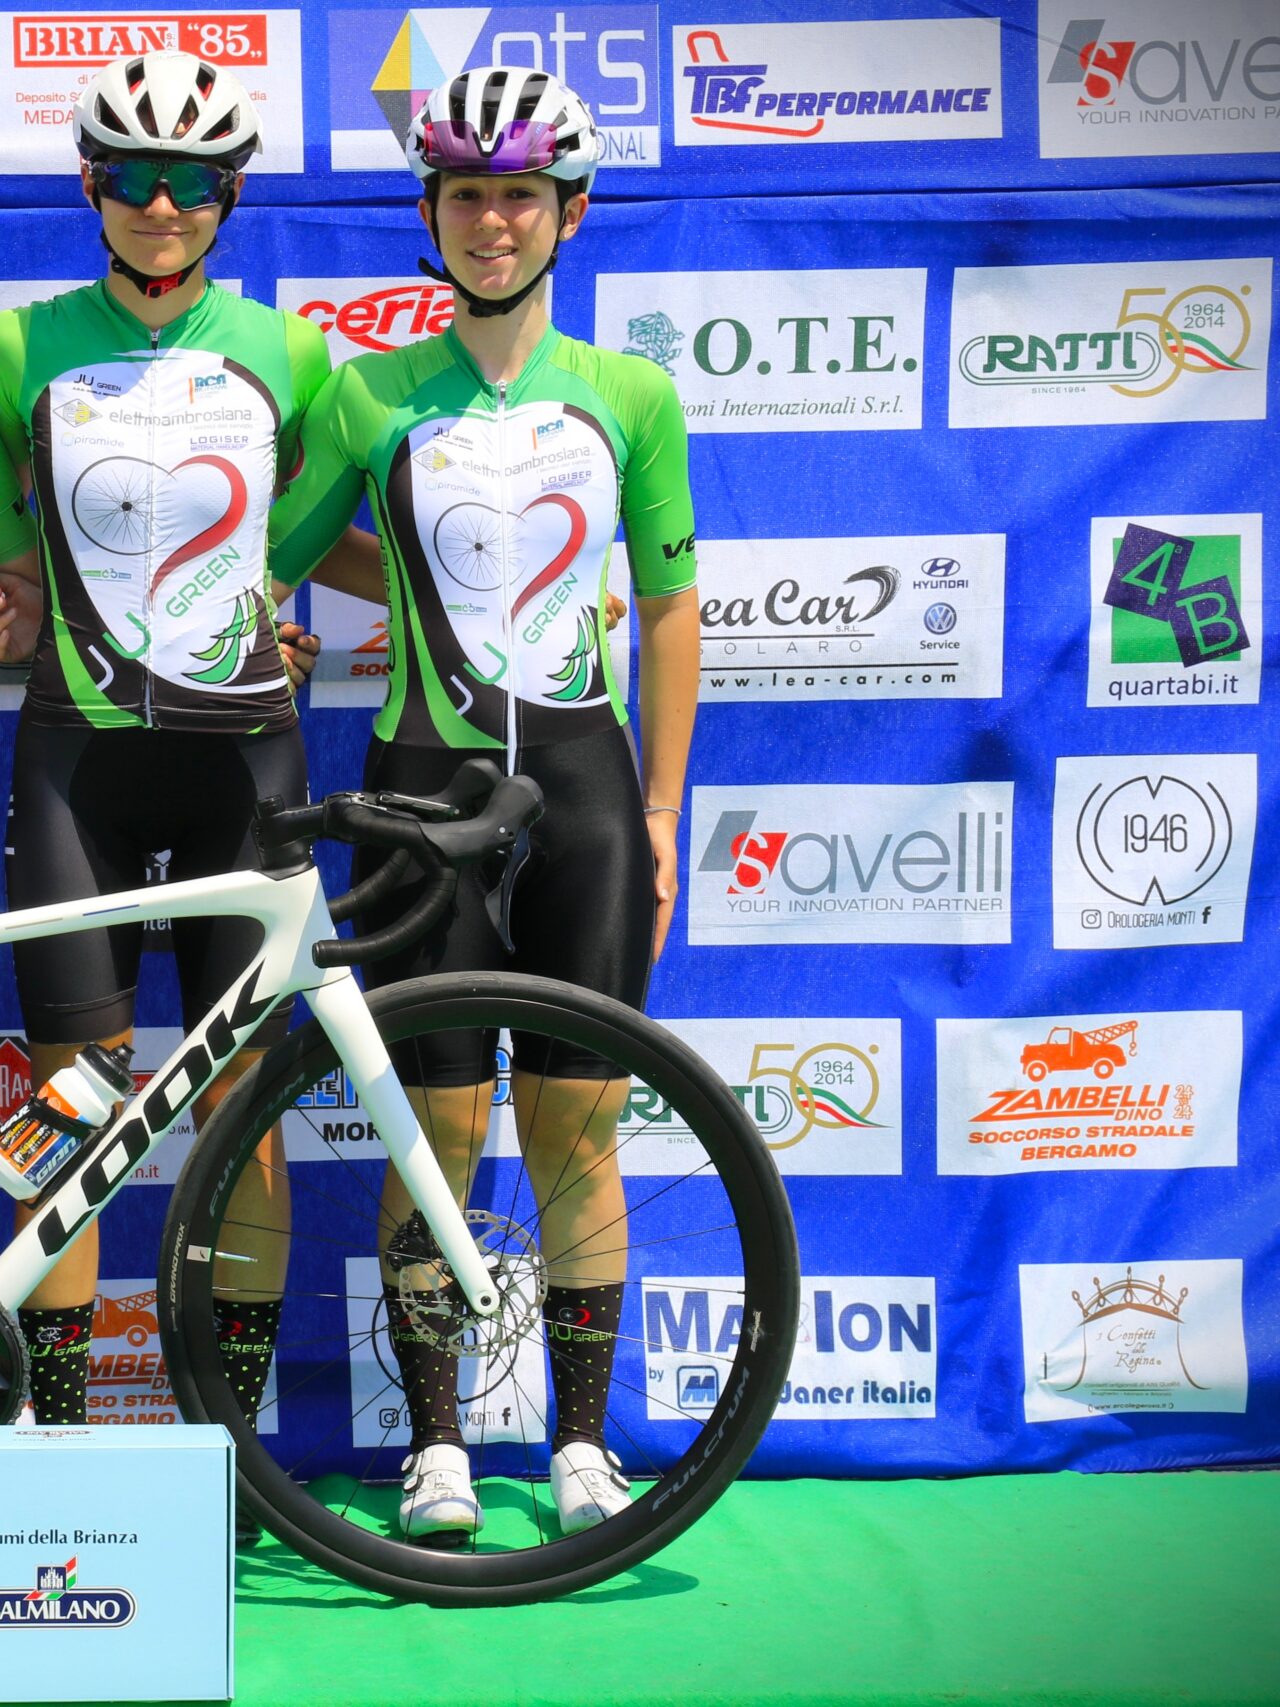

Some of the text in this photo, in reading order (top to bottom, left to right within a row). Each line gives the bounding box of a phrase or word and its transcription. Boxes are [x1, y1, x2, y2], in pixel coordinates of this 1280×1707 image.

[16, 92, 67, 104] Deposito
[755, 87, 991, 117] PERFORMANCE
[1078, 109, 1131, 125] YOUR
[1139, 107, 1255, 123] INNOVATION
[1183, 303, 1225, 316] 1964
[1184, 316, 1226, 329] 2014
[693, 316, 917, 376] O.T.E.
[982, 331, 1136, 373] RATTI
[96, 383, 121, 391] GREEN
[1032, 386, 1062, 394] SINCE
[721, 396, 855, 417] Internazionali
[862, 395, 903, 414] S.r.l.
[190, 435, 248, 445] LOGISER
[165, 544, 242, 618] GREEN
[913, 579, 969, 589] HYUNDAI
[522, 572, 578, 645] GREEN
[700, 580, 860, 626] ea Car
[920, 639, 960, 650] Service
[701, 672, 956, 687] ww.lea-car.com
[1108, 673, 1239, 698] quartabi.it
[1123, 813, 1187, 852] 1946
[727, 897, 1003, 913] YOUR INNOVATION PARTNER
[1167, 910, 1195, 927] MONTI
[814, 1061, 853, 1073] 1964
[814, 1073, 855, 1085] 2014
[37, 957, 280, 1257] LOOK
[968, 1084, 1169, 1122] ZAMBELLI
[1115, 1108, 1162, 1122] DINO
[968, 1124, 1194, 1145] SOCCORSO STRADALE
[1020, 1144, 1137, 1161] BERGAMO
[648, 1368, 931, 1404] by italia
[28, 1529, 67, 1545] della
[74, 1529, 138, 1545] Brianza
